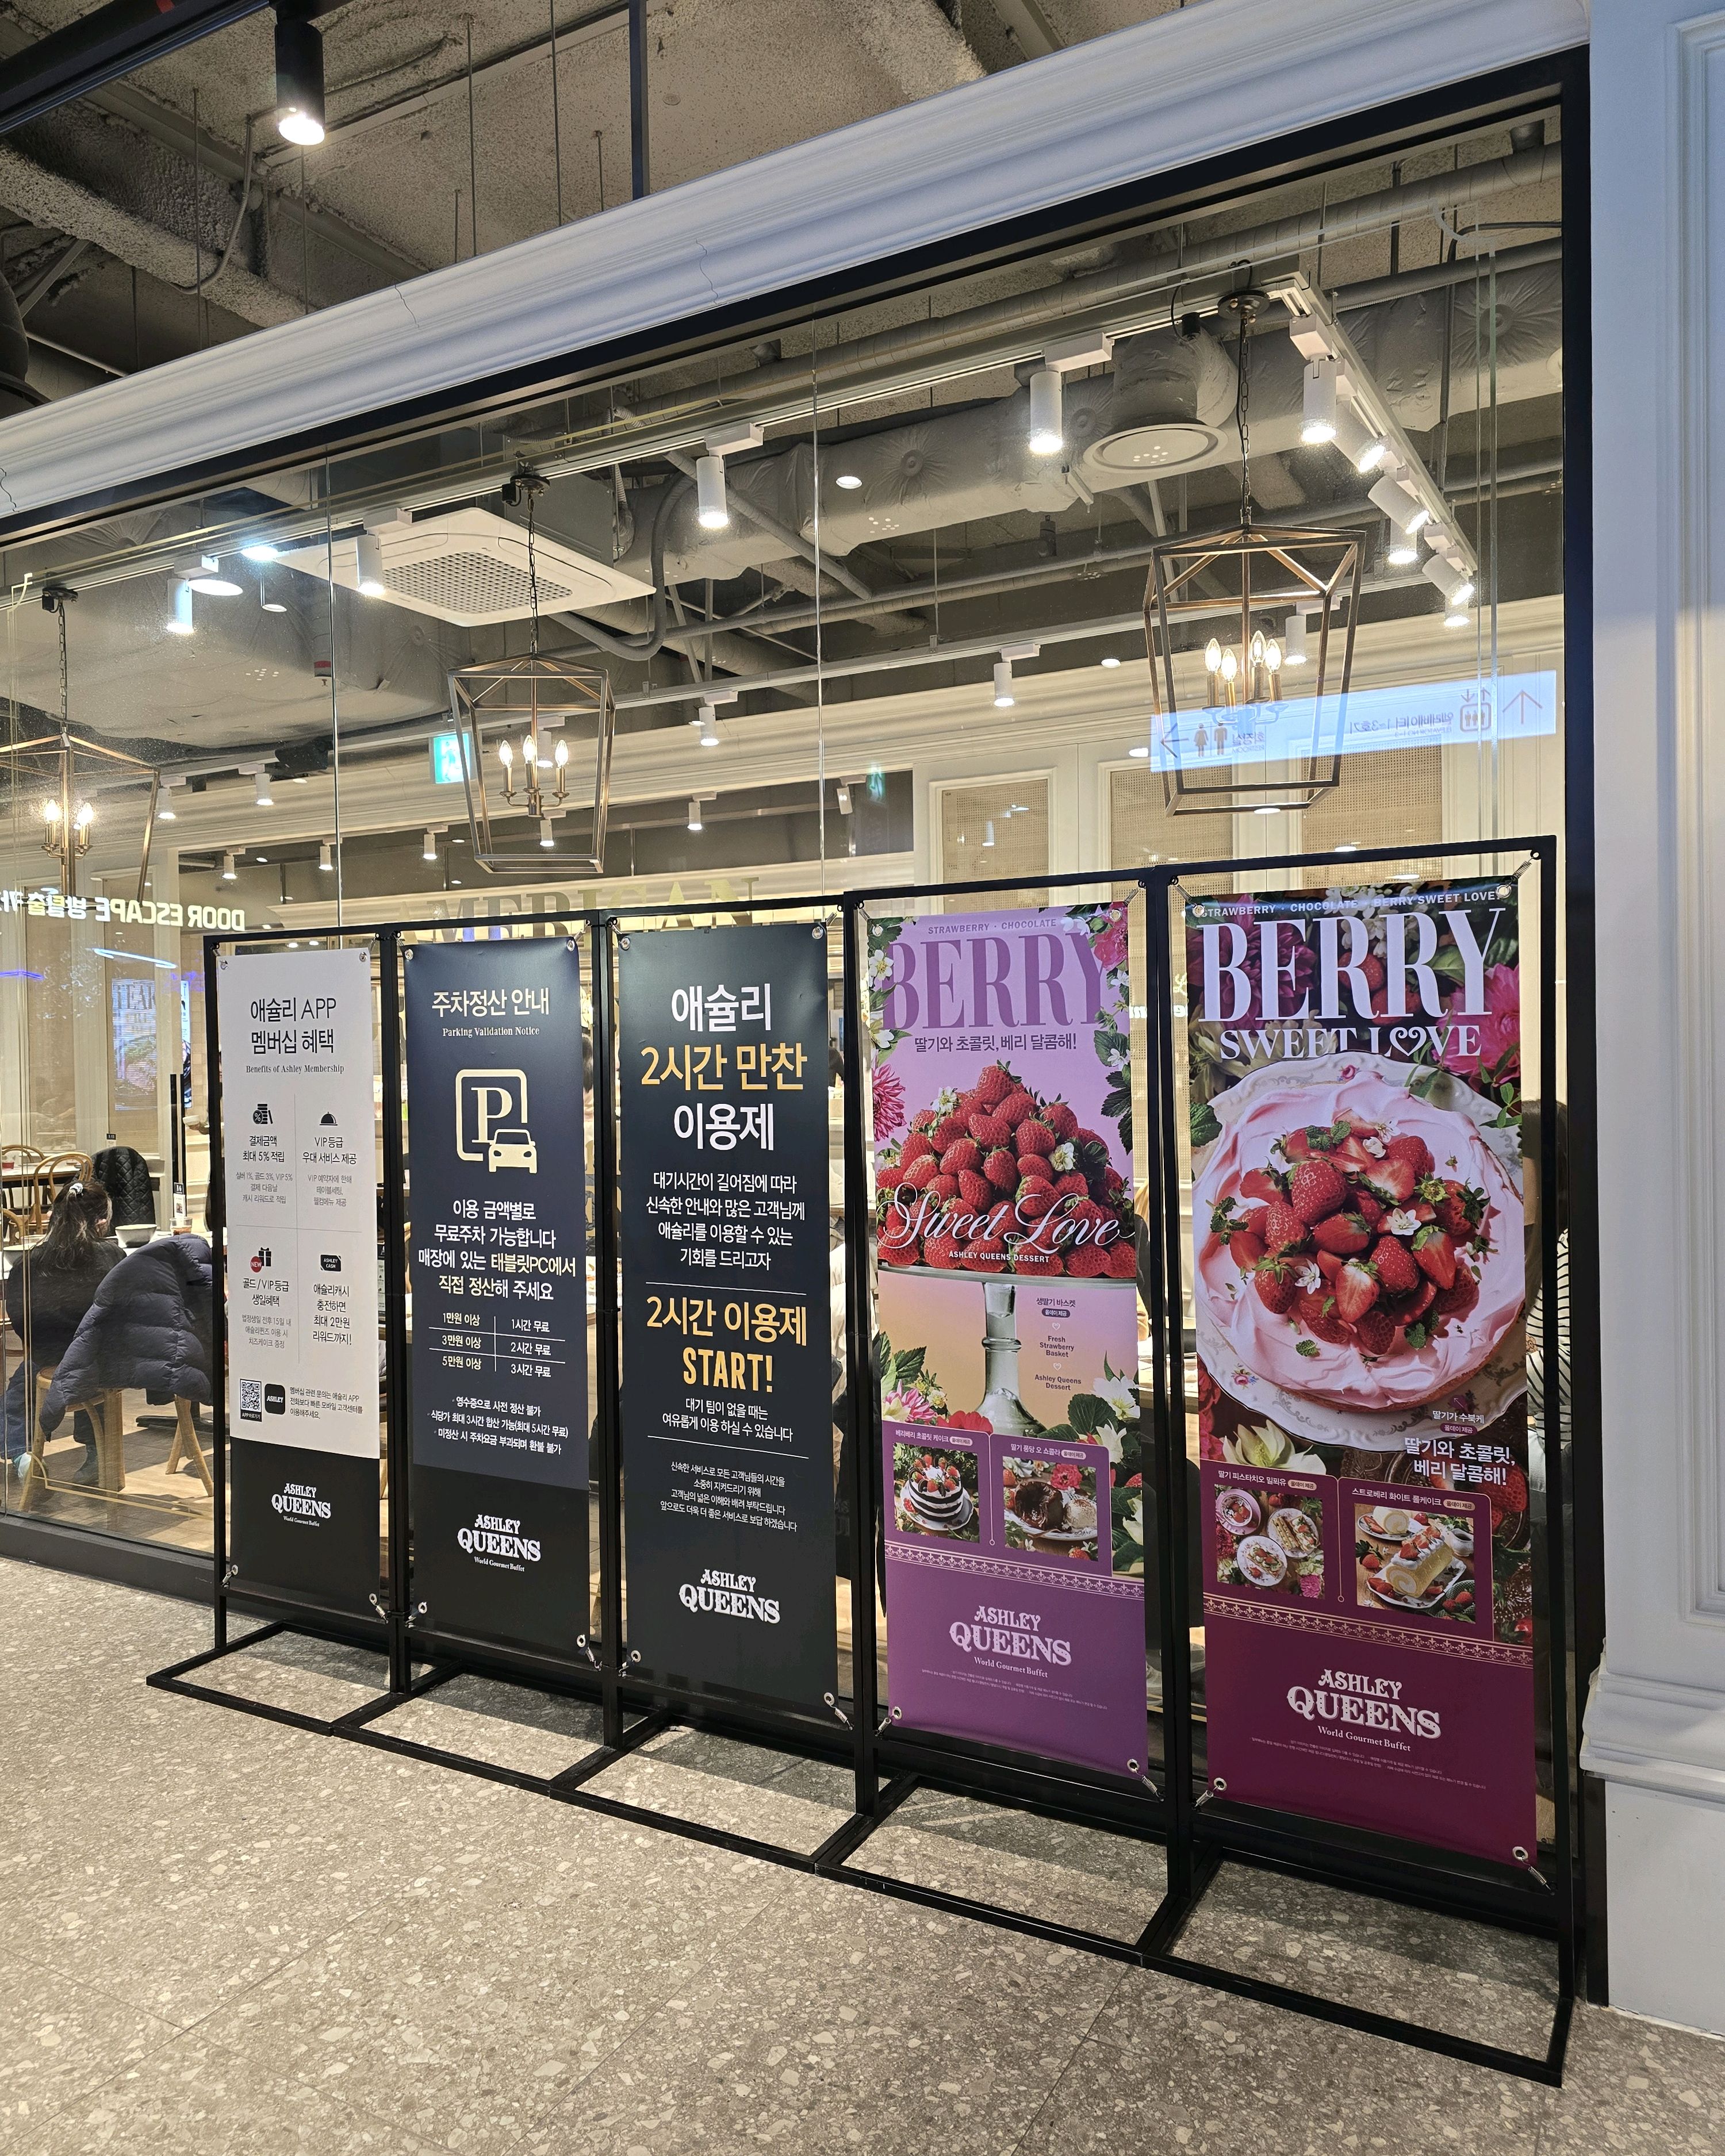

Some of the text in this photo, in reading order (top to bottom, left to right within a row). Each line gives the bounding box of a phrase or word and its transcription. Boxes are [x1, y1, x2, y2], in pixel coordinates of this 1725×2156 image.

[1290, 900, 1358, 912] CHOCOLATE
[1374, 896, 1413, 908] BERRY
[1417, 893, 1459, 905] SWEET
[928, 919, 1057, 935] STRAWBERRY CHOCOLATE
[1197, 908, 1505, 1023] BERRY
[883, 932, 1107, 1030] BERRY
[251, 998, 336, 1022] 애슐리 APP
[432, 987, 550, 1018] 주차정산 안내
[672, 983, 771, 1032] 애슐리
[251, 1029, 334, 1054] 멤버십 혜택
[443, 1026, 540, 1038] Parking Validation Notice
[914, 1036, 953, 1053] 딸기와
[1031, 1033, 1077, 1050] 달콤해!
[1220, 1028, 1356, 1060] SWEET
[281, 1065, 302, 1074] Ashley
[304, 1064, 344, 1074] Membership
[641, 1042, 808, 1091] 2시간 만찬
[674, 1103, 774, 1150] 이용제
[249, 1135, 277, 1147] 결제금액
[243, 1150, 285, 1163] 최대 5% 적립
[302, 1152, 357, 1165] 우대 서비스 제공
[653, 1172, 797, 1194] 대기시간이 길어짐에 따라
[453, 1199, 536, 1221] 이용 금액별로
[646, 1196, 805, 1221] 신속한 안내와 많은 고객님께
[876, 1182, 1136, 1255] Sweet Love
[434, 1224, 557, 1249] 무료주차 가능합니다
[658, 1221, 793, 1246] 애슐리를 이용할 수 있는
[419, 1248, 576, 1278] 매장에 있는 태블릿PC에서
[680, 1248, 772, 1271] 기회를 드리고자
[949, 1250, 1050, 1263] ASHLEY QUEENS DESSERT
[438, 1275, 554, 1301] 직접 정산해 주세요
[252, 1294, 279, 1307] 생일혜택
[317, 1300, 346, 1313] 충전하면
[1036, 1298, 1055, 1306] 생딸기
[314, 1315, 350, 1329] 최대 2만원
[443, 1312, 480, 1326] 1만원 이상
[511, 1319, 550, 1333] 1시간 무료
[646, 1296, 807, 1346] 2시간 이용제
[313, 1331, 352, 1345] 리워드까지!
[442, 1334, 481, 1349] 3만원 이상
[511, 1342, 551, 1356] 2시간 무료
[1040, 1342, 1075, 1352] Strawberry
[442, 1356, 482, 1370] 5만원 이상
[1046, 1350, 1069, 1358] Basket
[511, 1363, 551, 1378] 3시간 무료
[683, 1346, 773, 1392] START!
[1034, 1374, 1056, 1383] Ashley
[1046, 1382, 1071, 1391] Dessert
[456, 1396, 541, 1417] 영수증으로 사전 정산 불가
[686, 1398, 768, 1421] 대기 팀이 없을 때는
[431, 1410, 550, 1436] 식당가 최대 3시간 합산 5시간
[662, 1413, 793, 1442] 여유롭게 이용 하실 수 있습니다
[438, 1428, 561, 1455] 미정산 시 주차요금 부과되며 환불 불가
[1405, 1438, 1515, 1466] 딸기와 초콜릿,
[671, 1461, 785, 1487] 신속한 서비스로 모든 시간을
[1414, 1460, 1506, 1486] 베리 달콤해!
[283, 1483, 317, 1498] ASHLEY
[693, 1479, 761, 1498] 소중히 위해
[1352, 1488, 1411, 1502] 스트로베리 화이트
[271, 1494, 331, 1519] QUEENS
[474, 1514, 520, 1534] ASHLEY
[457, 1528, 541, 1562] QUEENS
[474, 1556, 525, 1572] World Gourmet Buffet
[700, 1569, 756, 1593] ASHLEY
[678, 1583, 780, 1624] QUEENS
[974, 1605, 1041, 1632] ASHLEY
[949, 1621, 1072, 1666] QUEENS
[973, 1656, 1048, 1678] World Gourmet Buffet
[1318, 1669, 1402, 1700] ASHLEY
[1287, 1686, 1441, 1739] QUEENS
[1318, 1725, 1411, 1752] World Gourmet Buffet
